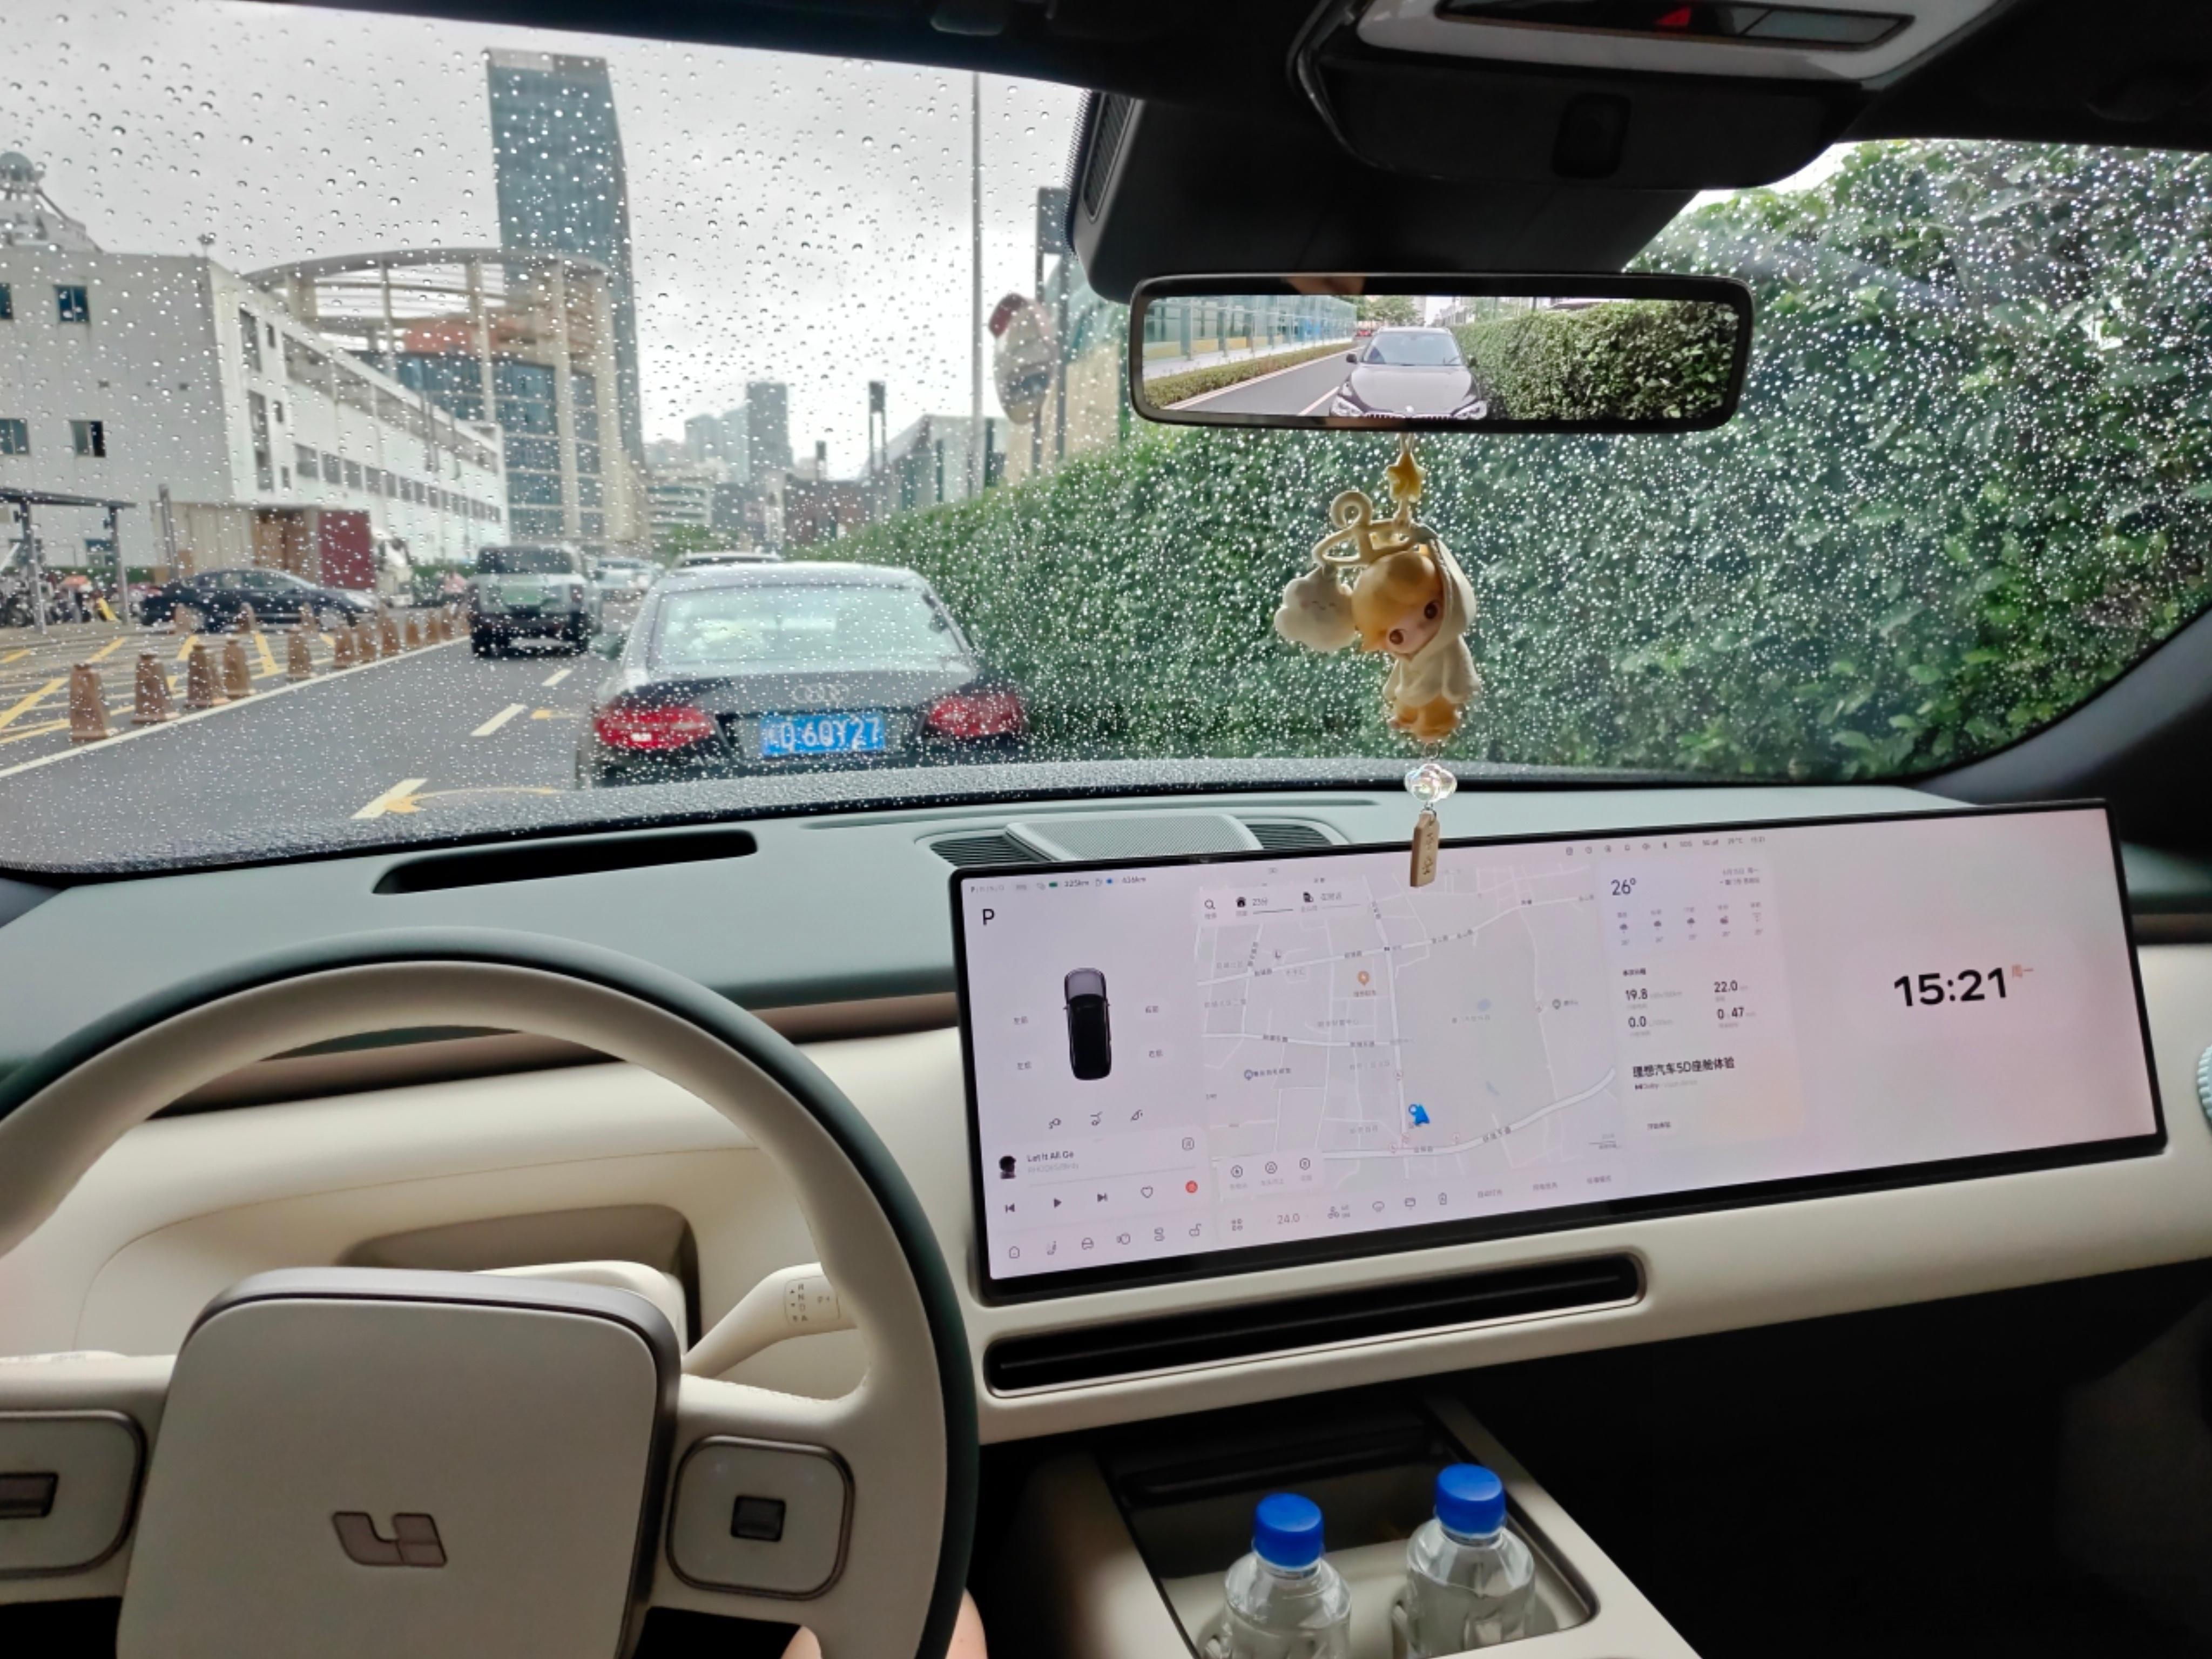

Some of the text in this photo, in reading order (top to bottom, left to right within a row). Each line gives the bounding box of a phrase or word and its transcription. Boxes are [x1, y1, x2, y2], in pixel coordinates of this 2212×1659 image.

[1611, 878, 1636, 896] 26°
[982, 908, 995, 926] P
[1714, 980, 1738, 993] 22.0
[1894, 967, 2007, 1007] 15:21
[1626, 988, 1648, 1001] 19.8
[1628, 1016, 1647, 1029] 0.0
[1633, 1056, 1735, 1078] 理想汽车5D座舱体验
[1277, 1213, 1300, 1225] 24.0
